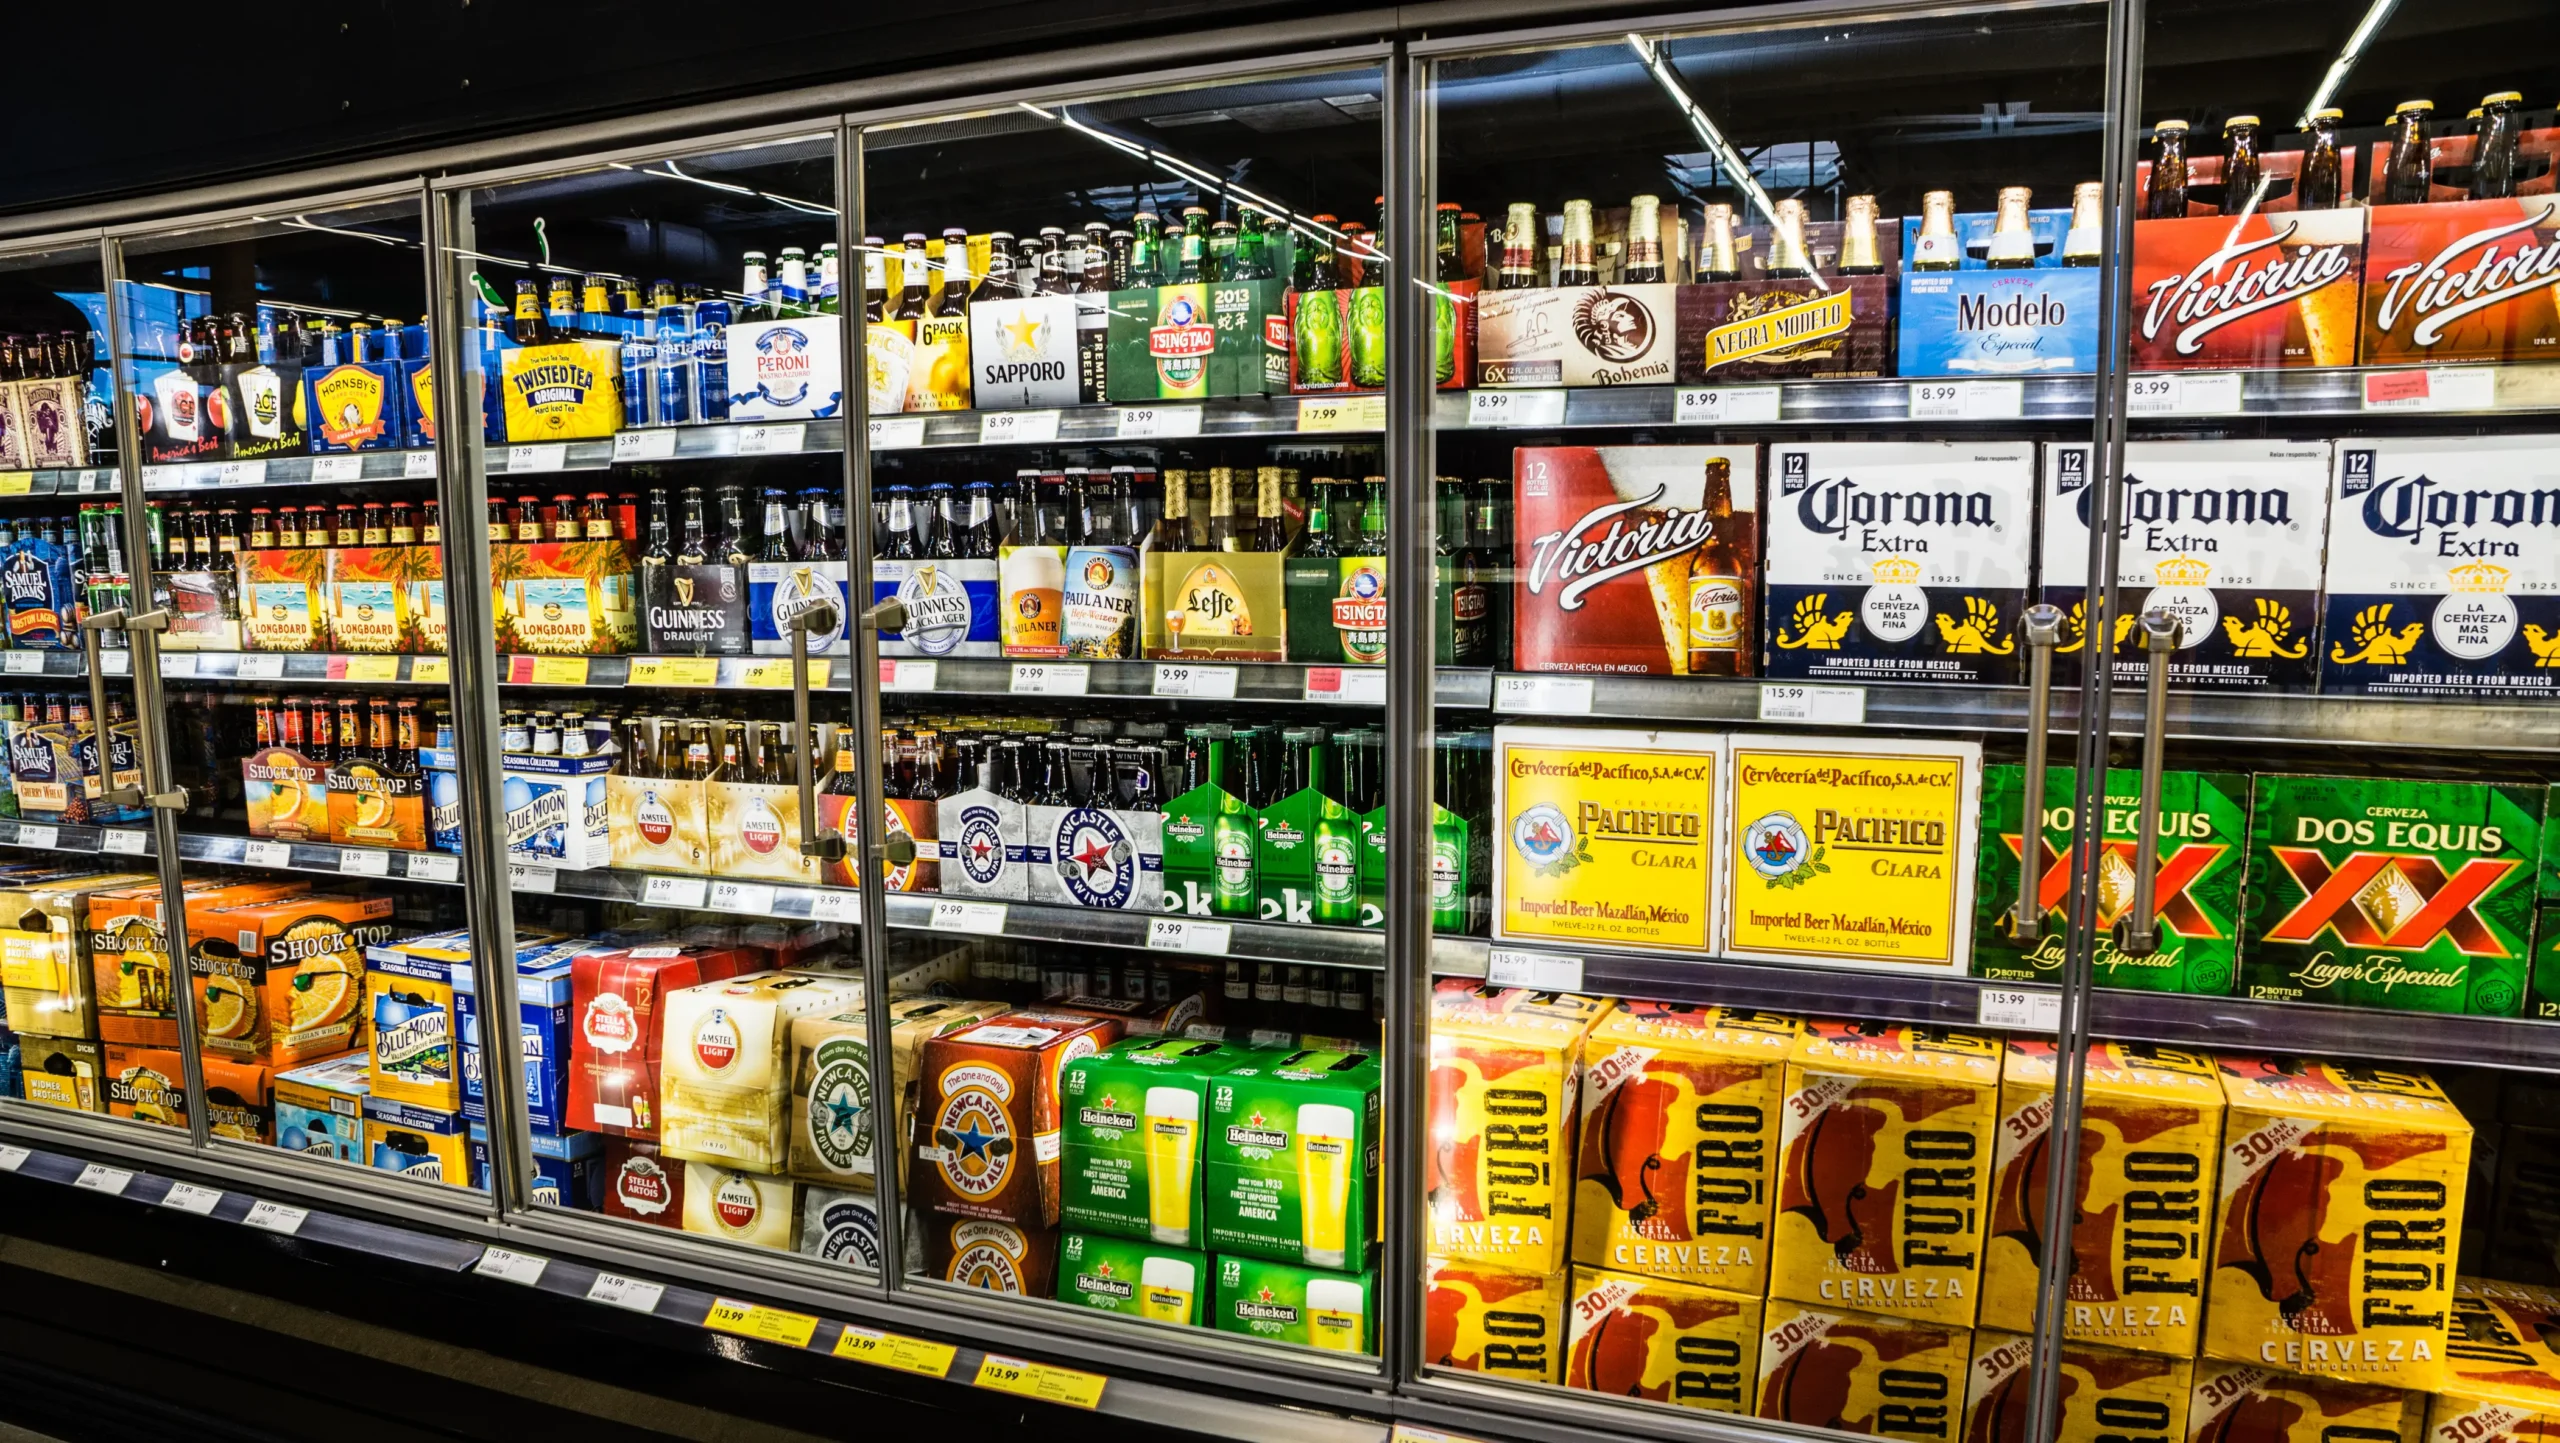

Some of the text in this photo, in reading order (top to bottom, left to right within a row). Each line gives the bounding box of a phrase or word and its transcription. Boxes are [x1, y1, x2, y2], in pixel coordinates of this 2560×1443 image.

[1214, 288, 1249, 304] 2013
[2142, 221, 2349, 355] Victoria
[1217, 312, 1248, 332] 蛇年
[1957, 293, 2066, 332] Modelo
[1152, 330, 1211, 349] TSINGTAO
[1714, 303, 1841, 358] NEGRA MODELO
[1977, 333, 2043, 356] Especial
[757, 356, 810, 375] PERONI
[986, 361, 1065, 386] SAPPORO
[1083, 351, 1092, 387] BEER
[1094, 333, 1105, 403] PREMIUM
[1592, 360, 1669, 386] Bohemia
[512, 365, 595, 395] TWISTED TEA
[534, 388, 577, 405] ORIGINAL
[1526, 462, 1548, 480] 12
[1786, 456, 1803, 473] 12
[2063, 452, 2081, 471] 12
[2349, 453, 2368, 473] 12
[1797, 477, 1996, 541] Corona
[1528, 483, 1713, 612] Victoria
[1861, 529, 1929, 553] Extra
[2146, 527, 2219, 553] Extra
[2437, 531, 2520, 558] Extra
[5, 569, 47, 588] SAMUEL
[1823, 573, 1863, 581] SINCE
[2390, 582, 2437, 590] SINCE
[2522, 582, 2557, 590] 1925
[1065, 591, 1134, 616] PAULANER
[1187, 588, 1235, 621] Leffe
[1870, 602, 1920, 611] CERVEZA
[1889, 593, 1902, 601] LA
[1883, 611, 1906, 619] MAS
[2467, 603, 2484, 612] LA
[650, 606, 726, 630] GUINNESS
[1011, 621, 1057, 634] PAULANER
[1882, 620, 1907, 629] FINA
[2443, 614, 2507, 623] CERVEZA
[256, 622, 308, 637] LONGBOARD
[341, 622, 394, 637] LONGBOARD
[523, 623, 586, 636] LONGBOARD
[664, 631, 715, 642] DRAUGHT
[2459, 625, 2489, 633] MAS
[2457, 636, 2489, 644] FINA
[1539, 662, 1648, 673] CERVEZA HECHA EN MEXICO
[1826, 657, 1961, 670] IMPORTED BEER FROM MEXICO
[2184, 664, 2250, 675] FROM MEXICO
[2389, 673, 2552, 686] IMPORTED BEER FROM MEXICO
[248, 765, 317, 785] SHOCK TOP
[328, 773, 407, 793] SHOCK TOP
[641, 813, 670, 824] AMSTEL
[1578, 800, 1700, 837] PACIFICO
[2366, 807, 2428, 820] CERVEZA
[645, 824, 667, 834] LIGHT
[745, 821, 776, 832] AMSTEL
[1060, 810, 1119, 855] NEWCASTLE
[1168, 823, 1203, 835] Heineken
[1814, 808, 1946, 846] PACIFICO
[2296, 816, 2503, 852] DOS EQUIS
[749, 832, 774, 843] LIGHT
[1265, 830, 1303, 843] Heineken
[692, 847, 701, 860] 6
[1631, 849, 1698, 870] CLARA
[1871, 859, 1942, 879] CLARA
[270, 924, 393, 967] SHOCK TOP
[190, 955, 257, 980] SHOCK TOP
[2289, 951, 2467, 993] Lager Especial
[634, 986, 651, 1008] 12
[2249, 986, 2303, 999] 12 BOTTLES
[594, 1021, 626, 1038] ARTOIS
[595, 1013, 626, 1029] STELLA
[701, 1033, 733, 1045] AMSTEL
[703, 1045, 729, 1058] LIGHT
[1616, 1049, 1633, 1065] CAN
[1620, 1052, 1643, 1071] PACK
[1070, 1070, 1087, 1085] 12
[1588, 1057, 1620, 1091] 30
[31, 1078, 62, 1092] WIDMER
[819, 1068, 870, 1105] NEWCASTLE
[1216, 1087, 1233, 1102] 12
[1817, 1078, 1836, 1094] CAN
[1822, 1081, 1847, 1101] PACK
[110, 1082, 182, 1110] SHOCK TOP
[1789, 1088, 1821, 1120] 30
[945, 1095, 1005, 1134] NEWCASTLE
[1081, 1110, 1135, 1130] Heineken
[2006, 1105, 2043, 1141] 30
[1155, 1123, 1187, 1136] Heineken
[1229, 1128, 1284, 1147] Heineken
[2267, 1121, 2289, 1139] CAN
[2272, 1124, 2301, 1147] PACK
[1306, 1141, 1341, 1155] Heineken
[1484, 1088, 1552, 1220] FURO
[2232, 1131, 2273, 1168] 30
[1696, 1103, 1763, 1240] FURO
[627, 1174, 659, 1189] STELLA
[627, 1184, 659, 1198] ARTOIS
[720, 1192, 753, 1205] AMSTEL
[1090, 1184, 1127, 1200] AMERICA
[1903, 1129, 1976, 1271] FURO
[723, 1203, 749, 1217] LIGHT
[1239, 1205, 1277, 1221] AMERICA
[2122, 1150, 2200, 1297] FURO
[1067, 1236, 1084, 1250] 12
[1614, 1244, 1754, 1266] CERVEZA
[2362, 1178, 2447, 1332] FURO
[956, 1249, 1017, 1292] NEWCASTLE
[1223, 1262, 1241, 1276] 12
[1078, 1276, 1130, 1297] Heineken
[1819, 1277, 1965, 1299] CERVEZA
[1150, 1293, 1183, 1306] Heineken
[1577, 1290, 1608, 1322] 30
[1239, 1303, 1295, 1322] Heineken
[1317, 1316, 1352, 1329] Heineken
[1768, 1321, 1801, 1355] 30
[2260, 1338, 2434, 1363] CERVEZA
[1980, 1346, 2015, 1382] 30
[2198, 1374, 2240, 1409] 30
